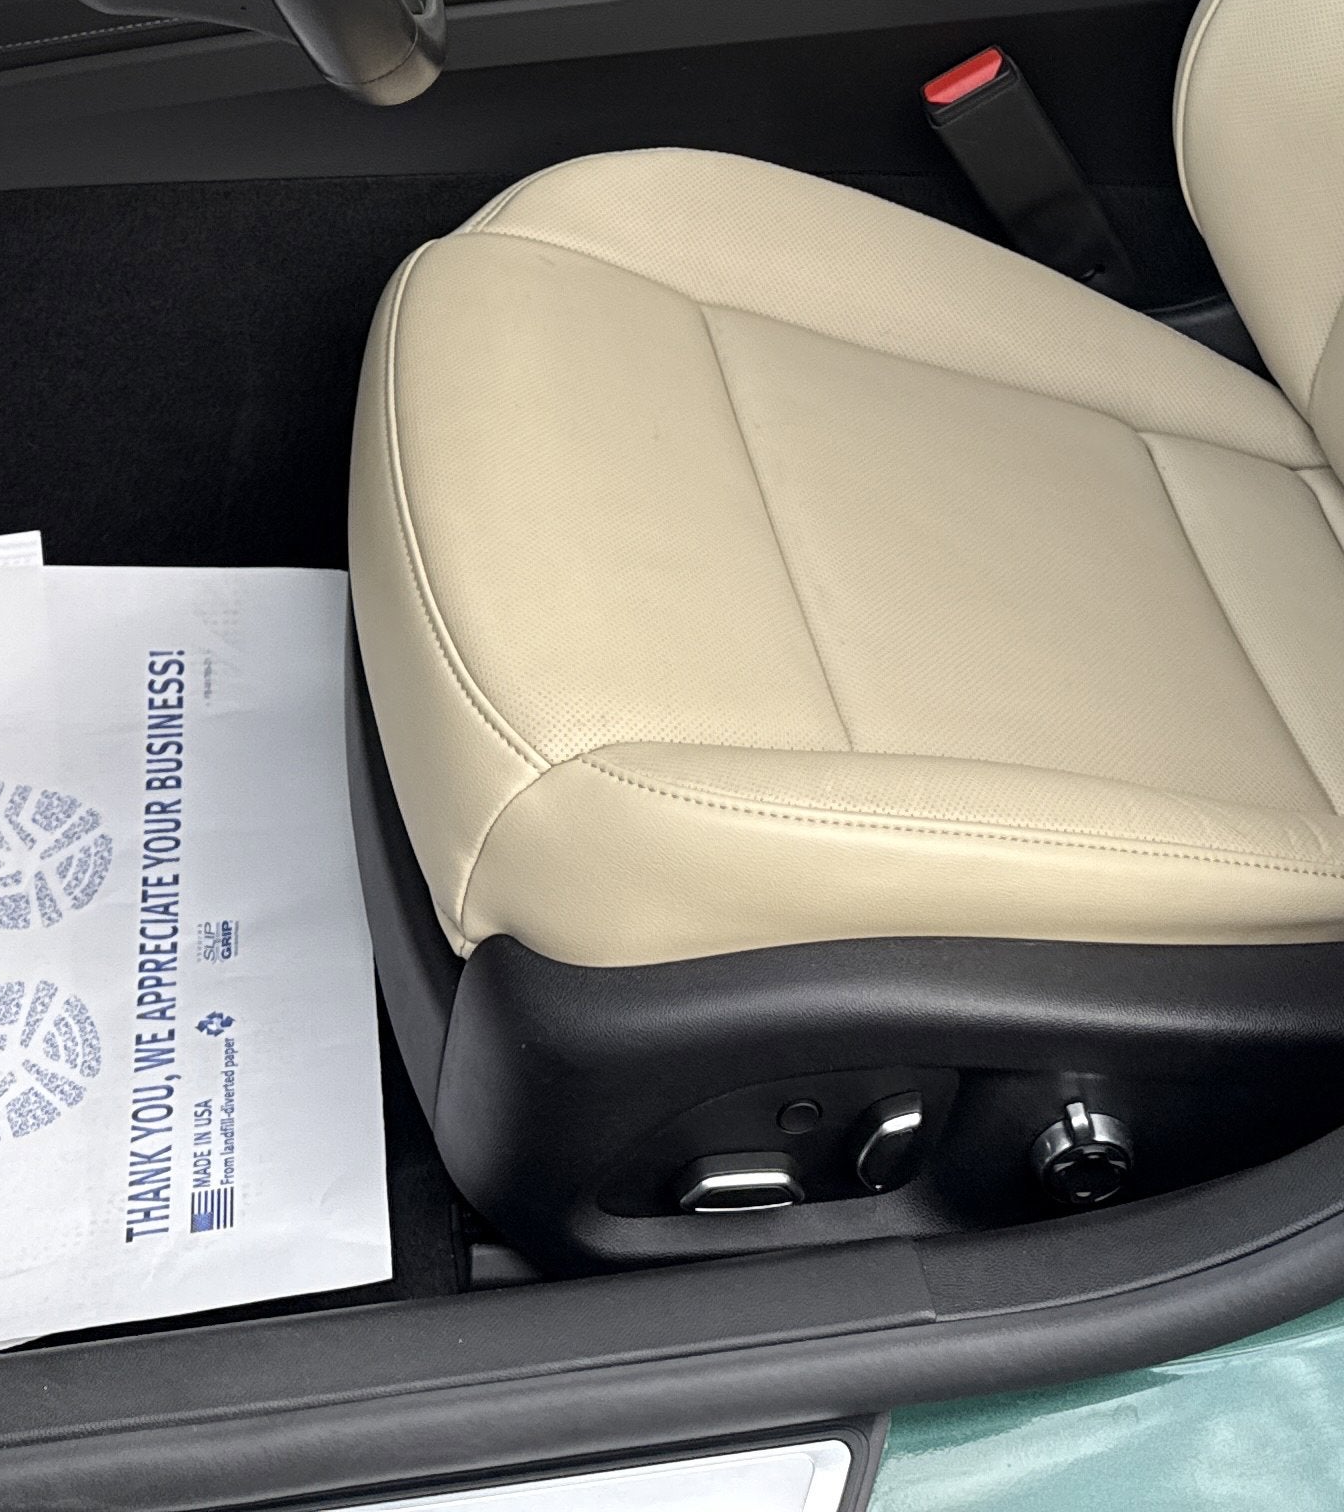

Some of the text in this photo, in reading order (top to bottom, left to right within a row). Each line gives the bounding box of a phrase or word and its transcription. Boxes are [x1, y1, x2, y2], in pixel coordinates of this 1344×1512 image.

[125, 649, 186, 1244] THANK YOU, WE APPRECIATE YOUR BUSINESS!
[203, 920, 216, 961] SLIP
[221, 919, 233, 960] GRIP
[192, 1098, 213, 1188] MADE IN USA
[218, 1037, 241, 1186] From landfill-diverted paper
